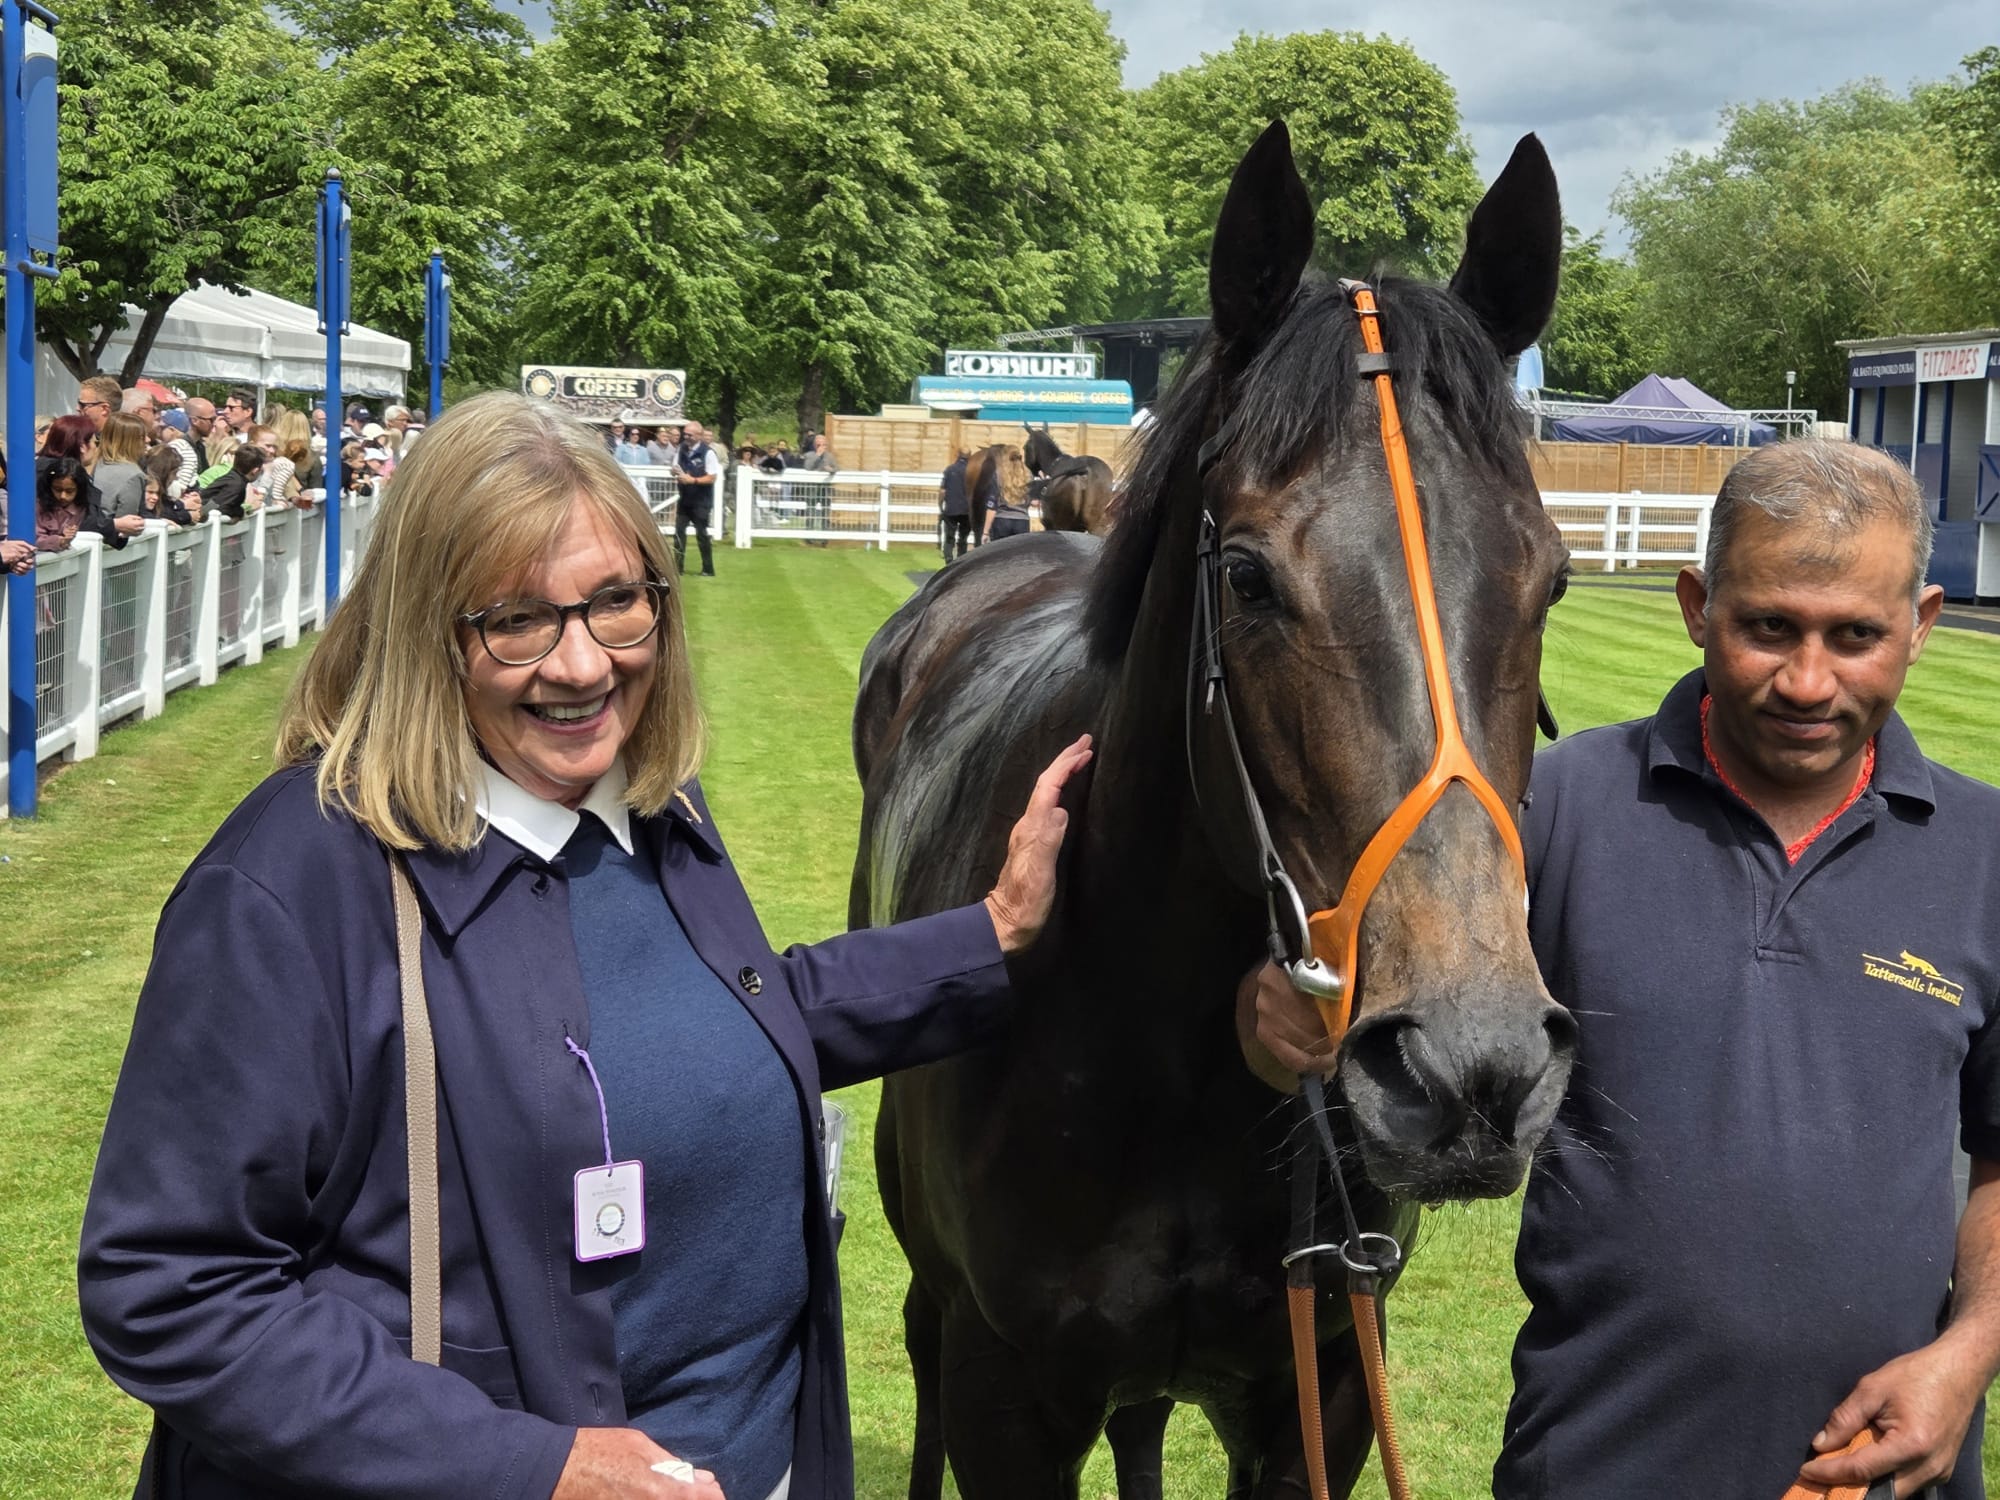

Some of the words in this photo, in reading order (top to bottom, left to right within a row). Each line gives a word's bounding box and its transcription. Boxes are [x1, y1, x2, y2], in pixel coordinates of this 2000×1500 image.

[1922, 348, 1979, 376] FITZDARES
[575, 378, 638, 398] COFFEE
[1040, 391, 1085, 404] GOURMET
[1091, 392, 1129, 404] COFFEE
[1865, 963, 1925, 992] Tattersalls
[1927, 983, 1962, 1006] Ireland
